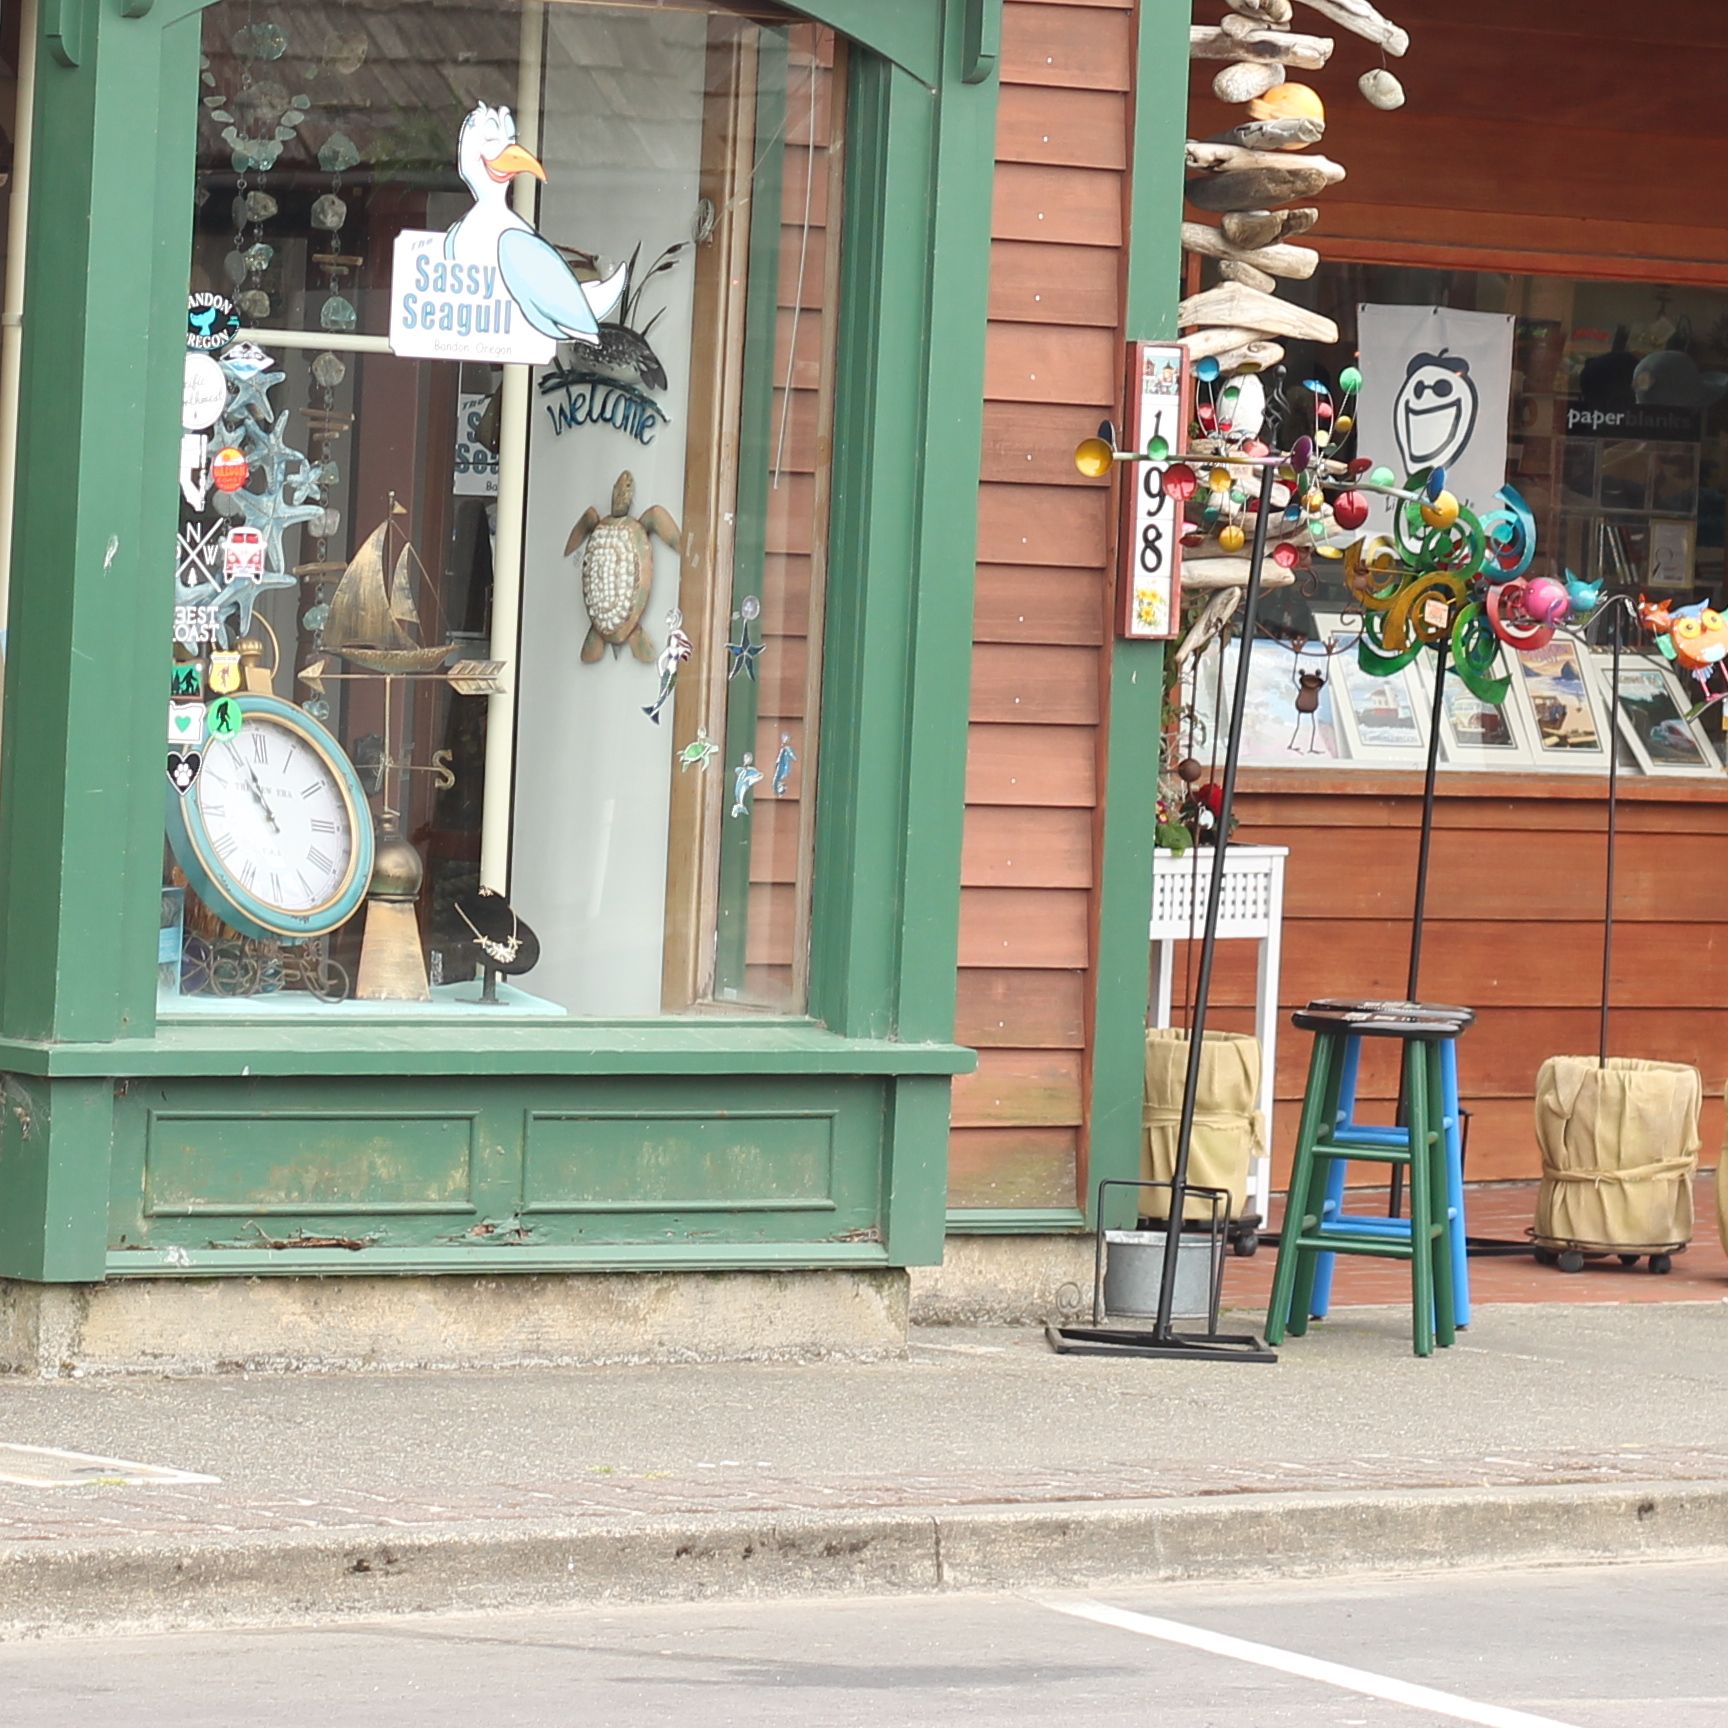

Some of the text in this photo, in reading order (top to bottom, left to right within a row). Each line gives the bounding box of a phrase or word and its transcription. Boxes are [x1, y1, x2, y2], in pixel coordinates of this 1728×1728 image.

[415, 254, 497, 299] Sassy
[188, 292, 232, 315] ANDON
[402, 293, 512, 337] Seagull
[186, 329, 229, 349] REGON
[476, 342, 513, 356] Oregon
[173, 624, 219, 642] OAST
[432, 749, 455, 790] S
